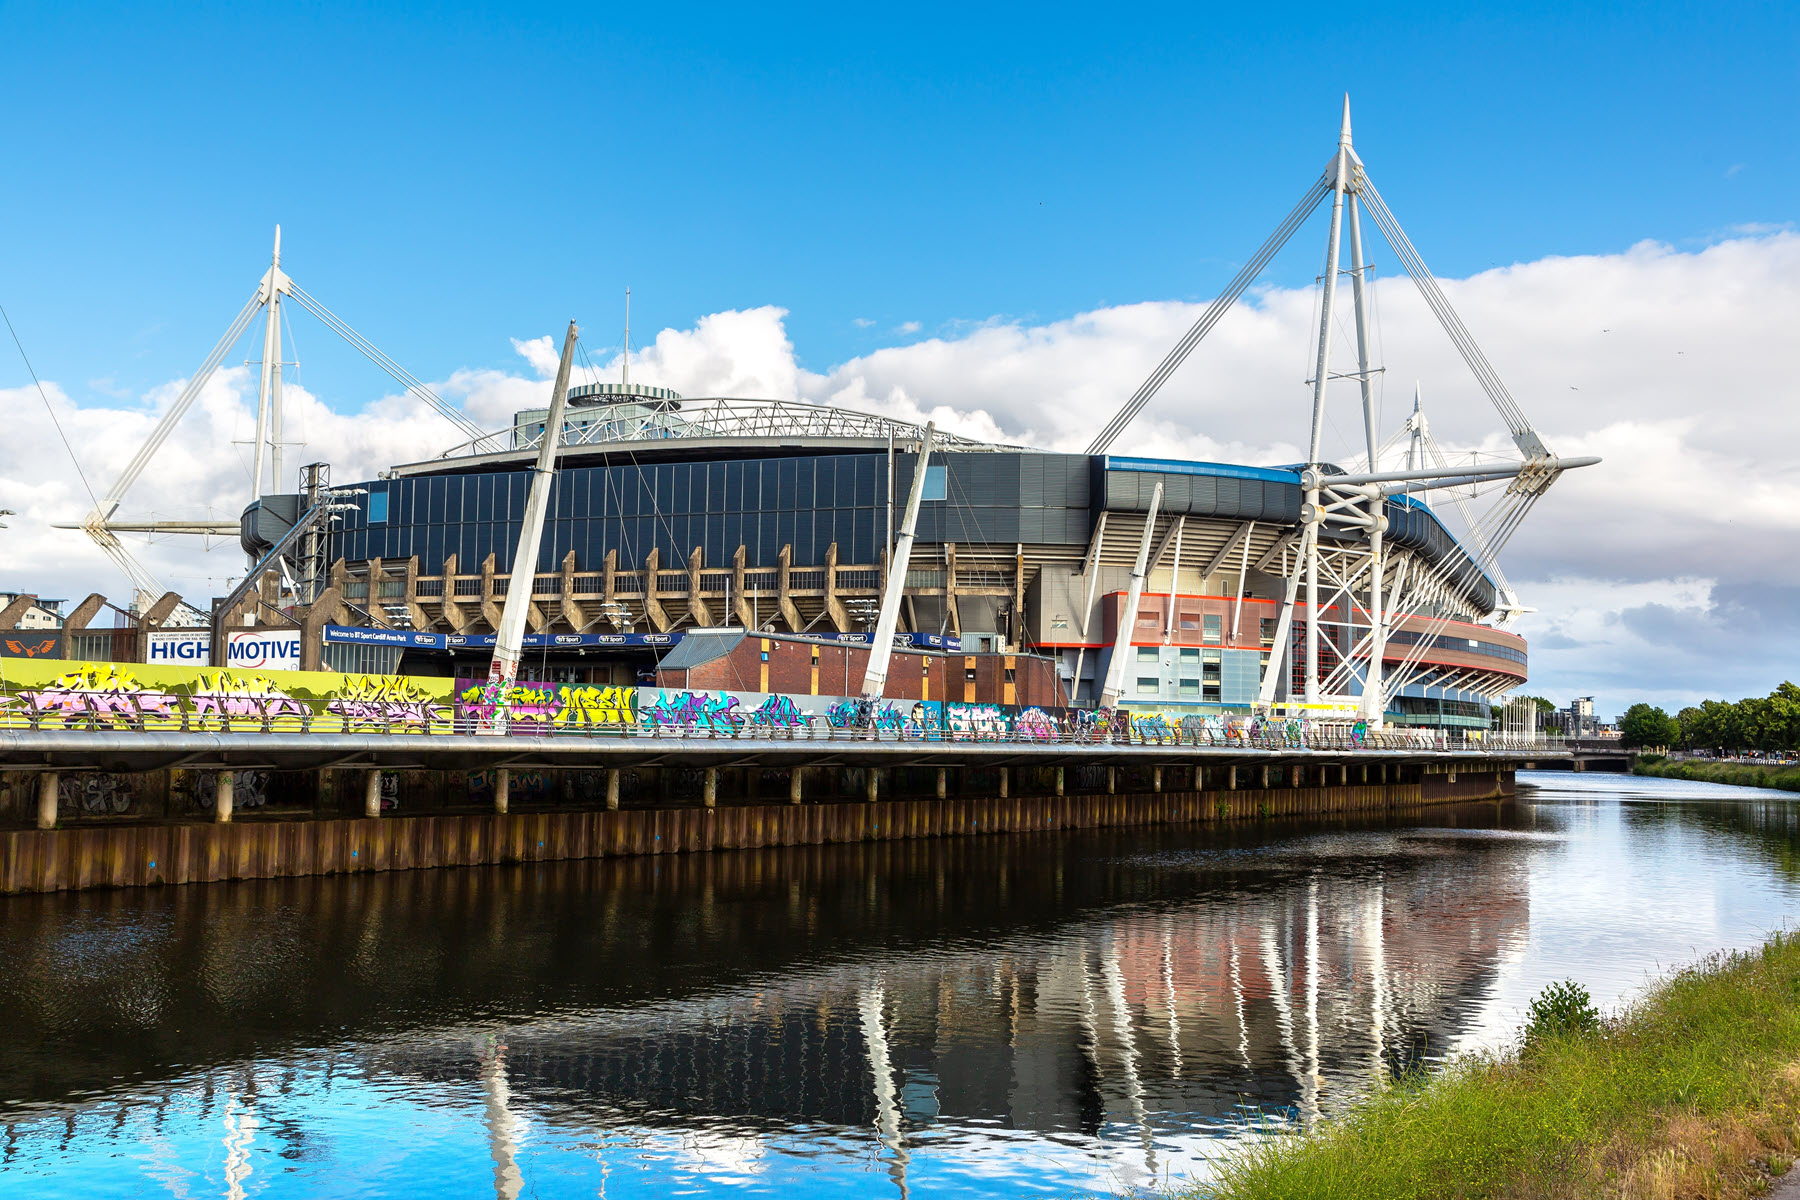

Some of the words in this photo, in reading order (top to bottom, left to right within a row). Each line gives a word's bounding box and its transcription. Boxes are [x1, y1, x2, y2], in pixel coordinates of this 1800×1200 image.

[330, 630, 349, 638] Welcome
[361, 632, 372, 640] Sport
[152, 642, 210, 659] HIGH
[228, 640, 300, 660] MOTIVE
